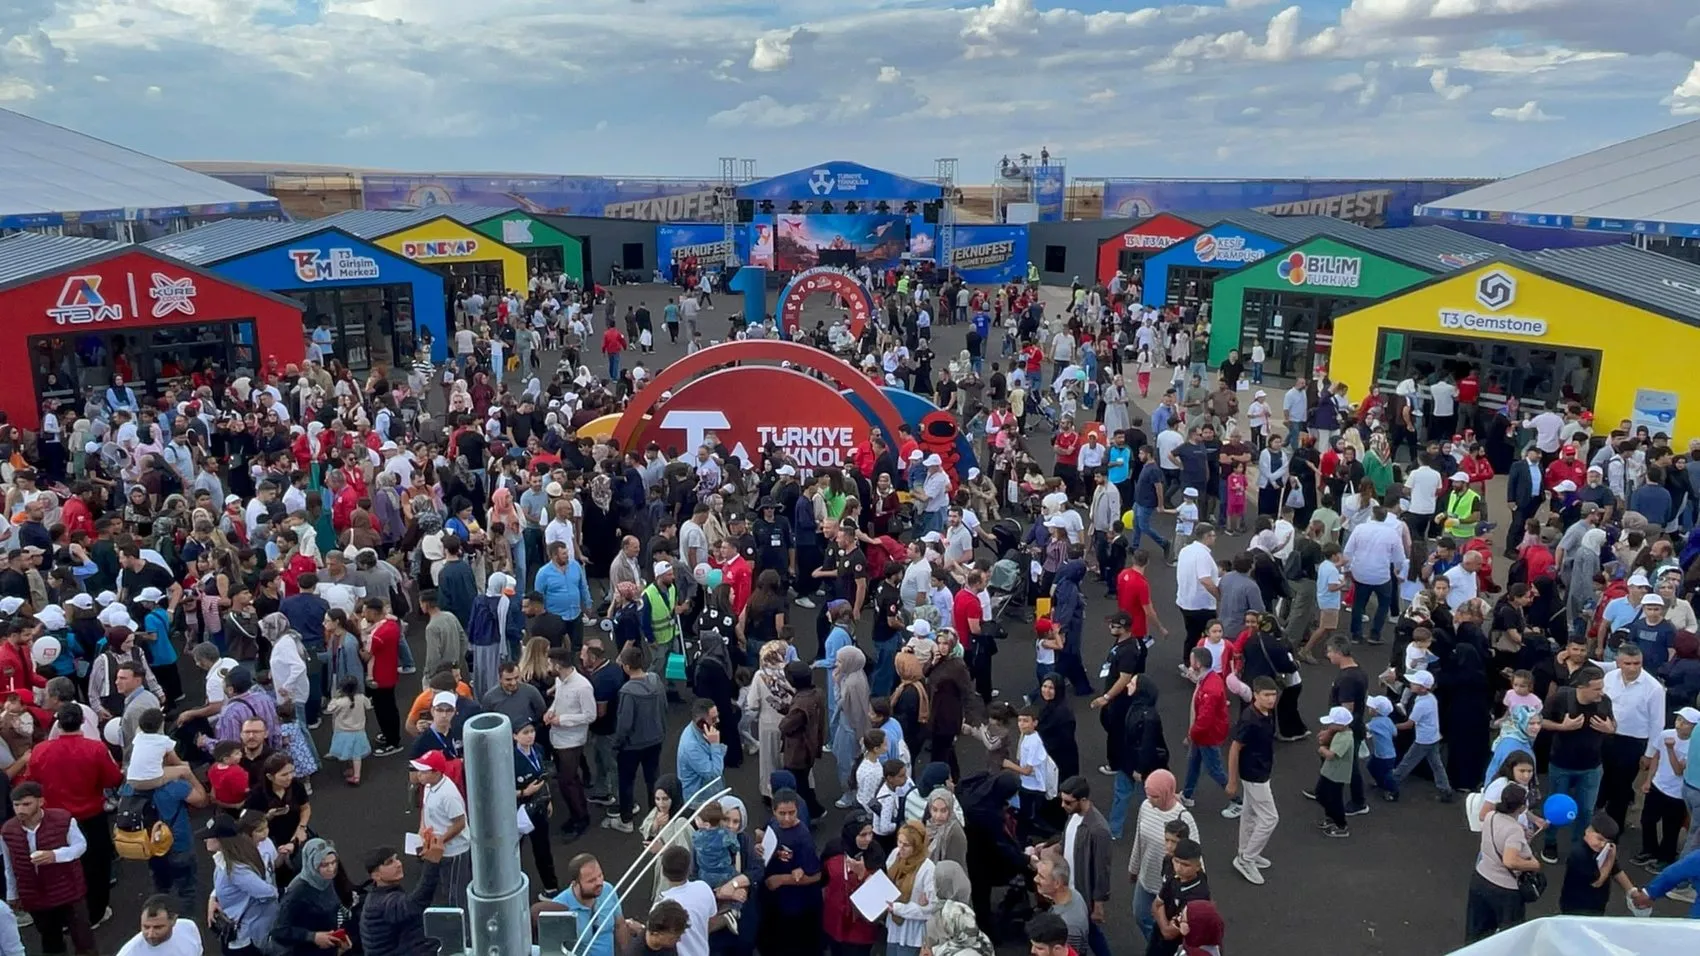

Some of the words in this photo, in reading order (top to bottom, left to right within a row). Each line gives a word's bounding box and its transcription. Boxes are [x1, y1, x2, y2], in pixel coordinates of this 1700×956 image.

[339, 250, 351, 259] T3
[404, 240, 477, 256] DENEYAP
[951, 241, 1015, 260] TEKNOFEST
[339, 259, 374, 269] Girişim
[1308, 257, 1358, 275] BİLİM
[339, 268, 378, 277] Merkezi
[152, 286, 195, 297] KÜRE
[1441, 312, 1460, 326] T3
[1463, 314, 1543, 333] Gemstone
[757, 427, 854, 447] TÜRKİYE
